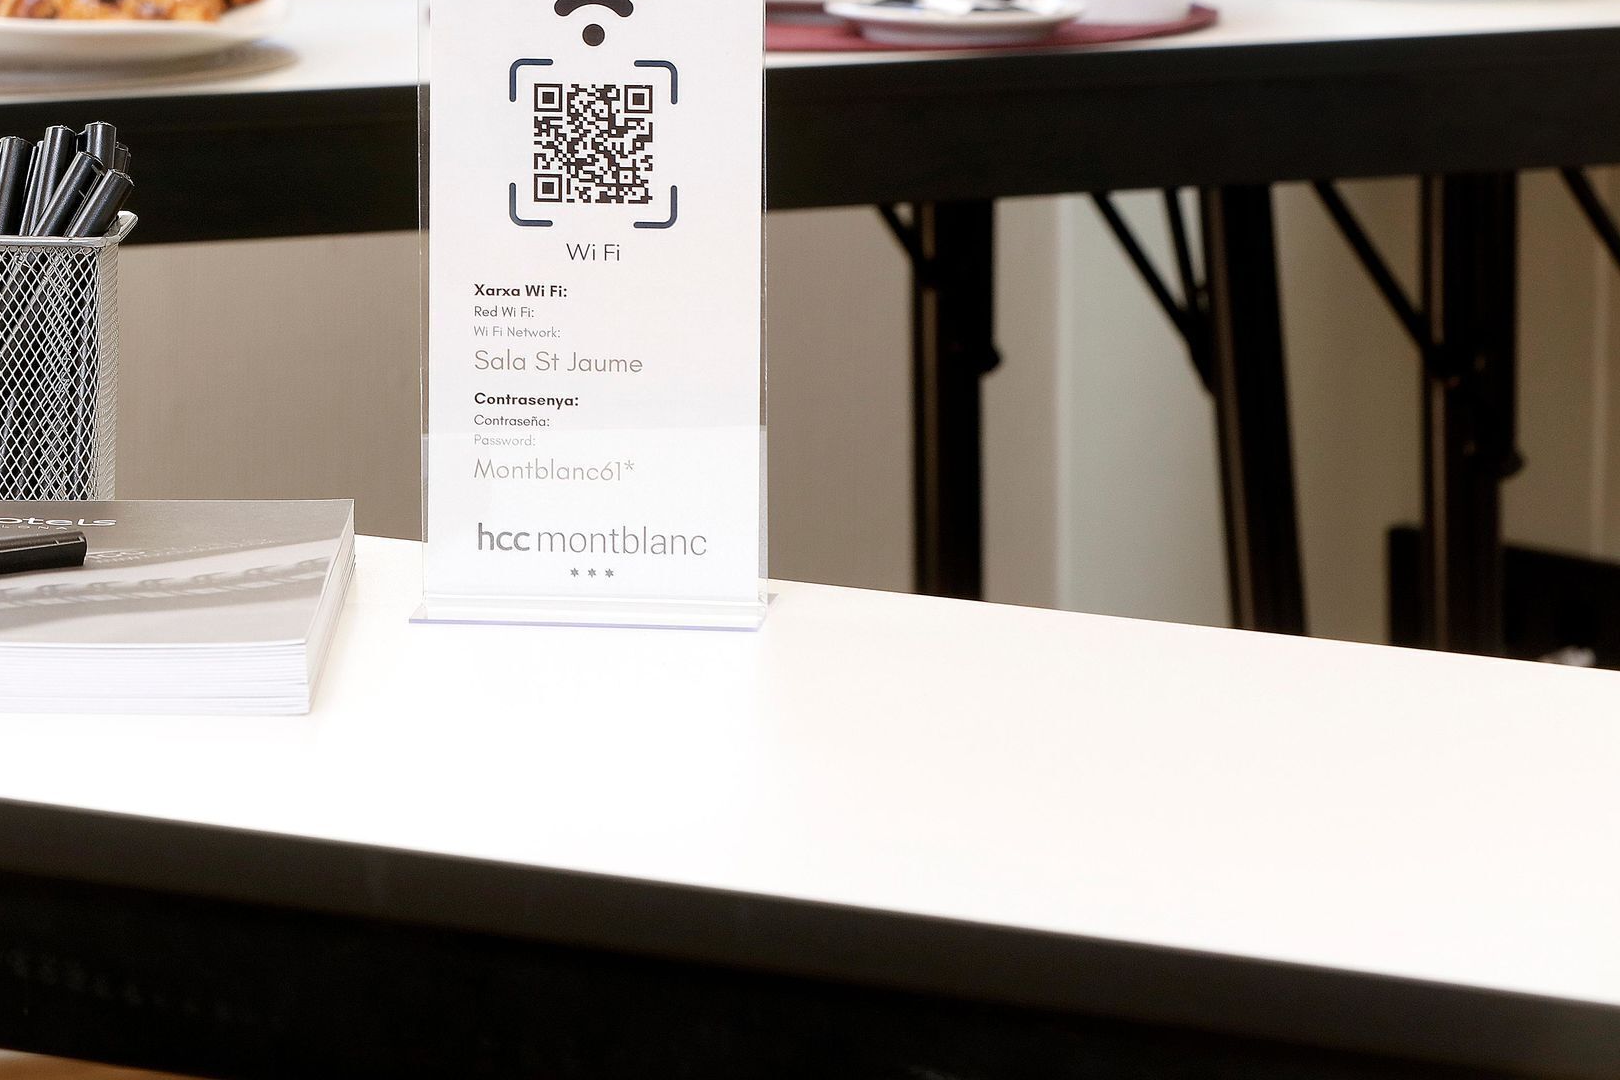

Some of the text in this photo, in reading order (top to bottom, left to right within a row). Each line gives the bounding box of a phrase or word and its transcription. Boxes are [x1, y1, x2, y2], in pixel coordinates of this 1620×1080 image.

[566, 242, 621, 262] Wi Fi
[473, 283, 568, 299] Xarxa Wi Fi:
[473, 305, 535, 319] Red Wi Fi:
[473, 325, 562, 340] Wi Fi Network:
[474, 348, 644, 374] Sala St Jaume
[473, 392, 580, 410] Contrasenya:
[473, 414, 551, 428] Contraseña:
[473, 433, 537, 447] Password:
[476, 521, 708, 556] hcc montblanc
